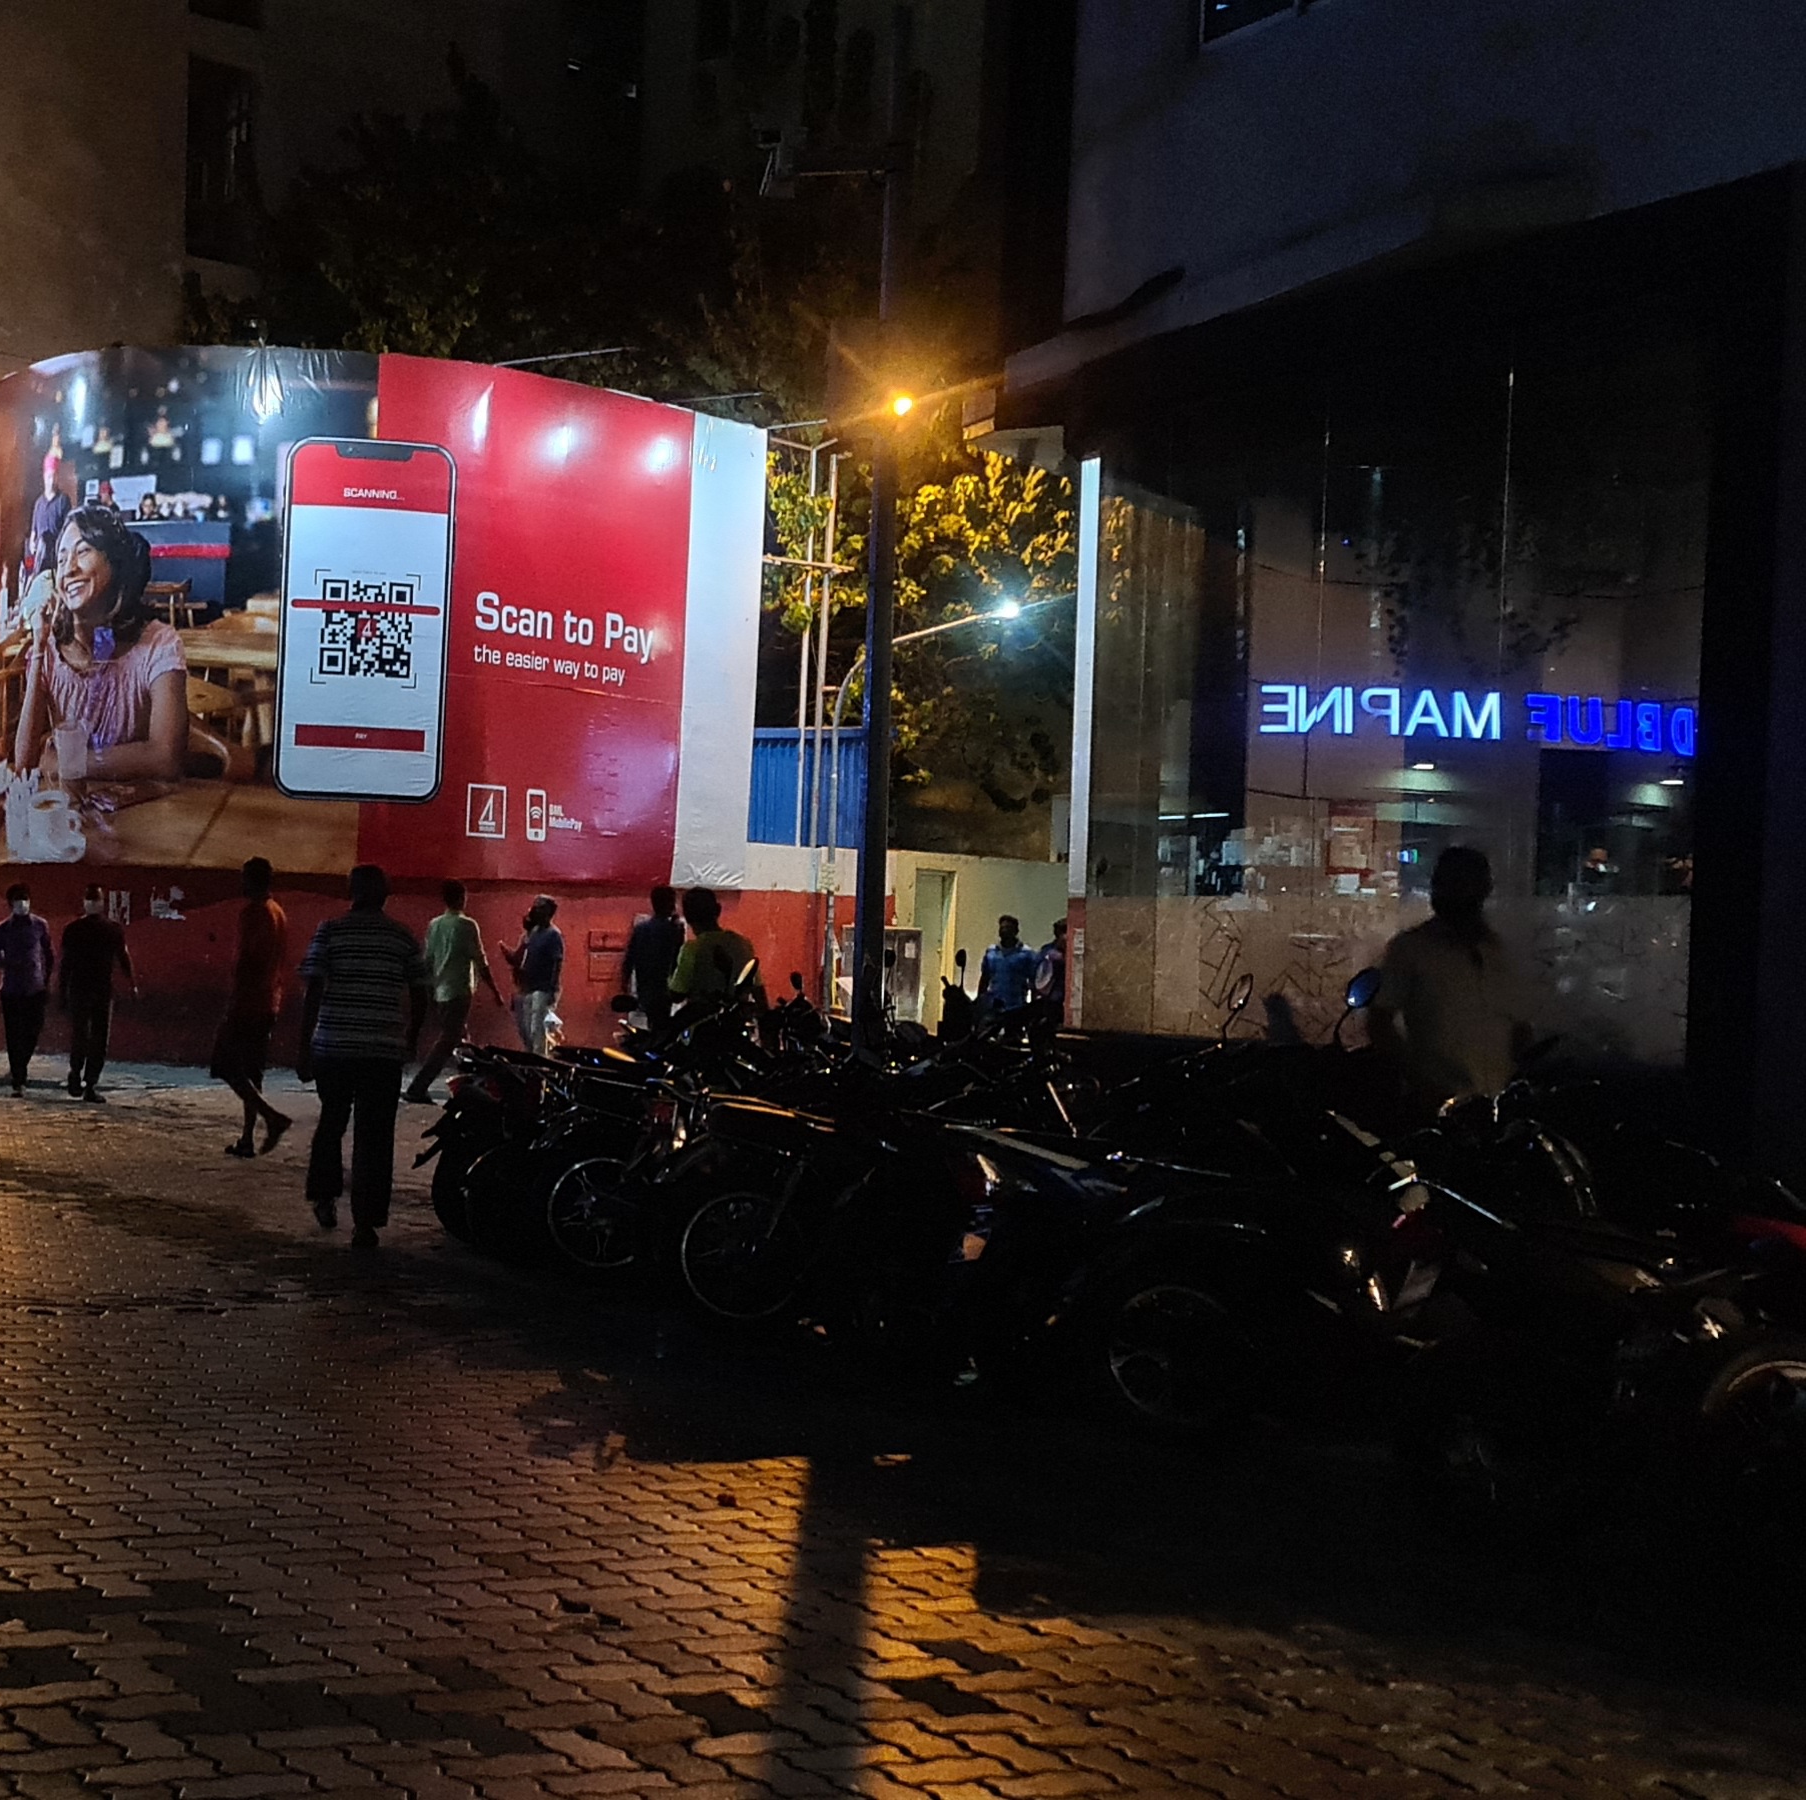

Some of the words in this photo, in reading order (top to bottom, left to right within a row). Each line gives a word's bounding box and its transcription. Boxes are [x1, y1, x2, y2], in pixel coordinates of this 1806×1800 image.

[475, 591, 553, 640] Scan
[564, 610, 594, 646] to
[605, 611, 654, 664] Pay
[474, 644, 502, 665] the
[506, 650, 550, 672] easier
[554, 659, 581, 680] way
[584, 661, 599, 679] to
[602, 666, 626, 687] pay
